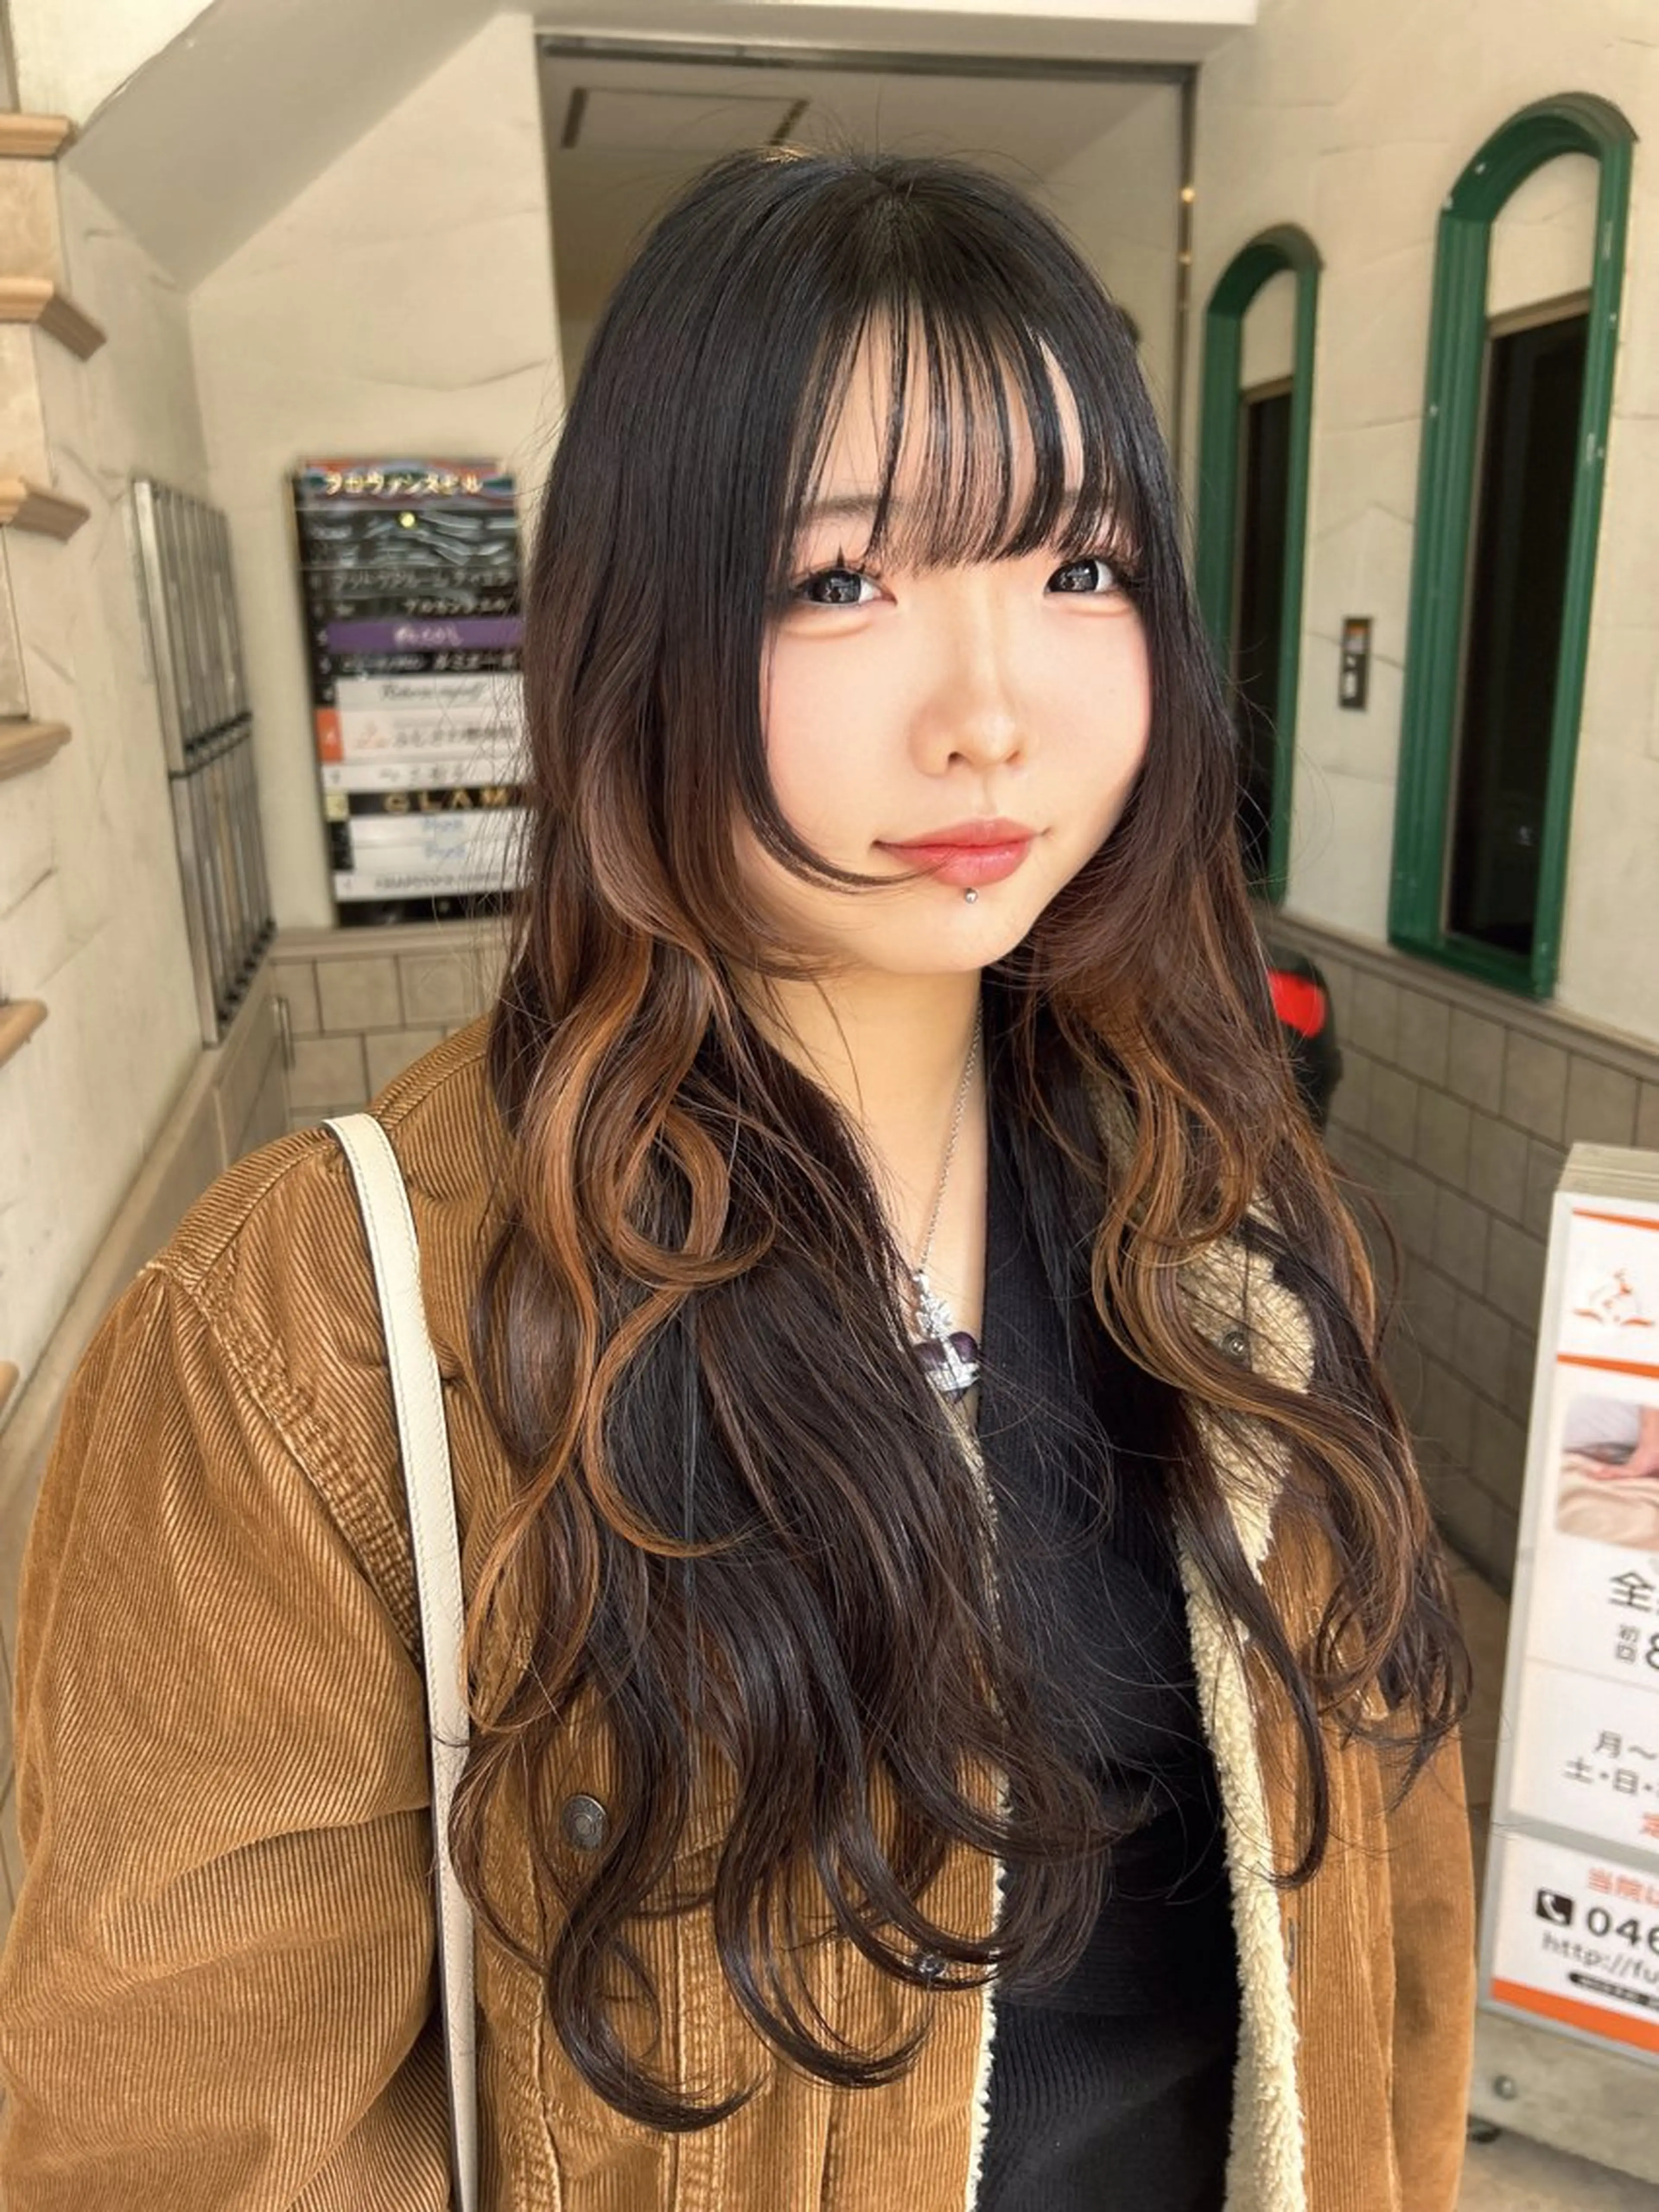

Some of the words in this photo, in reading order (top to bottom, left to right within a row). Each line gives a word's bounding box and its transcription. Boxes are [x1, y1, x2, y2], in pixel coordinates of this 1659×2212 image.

[1608, 1571, 1659, 1615] 全
[1561, 1757, 1659, 1796] 土・日・
